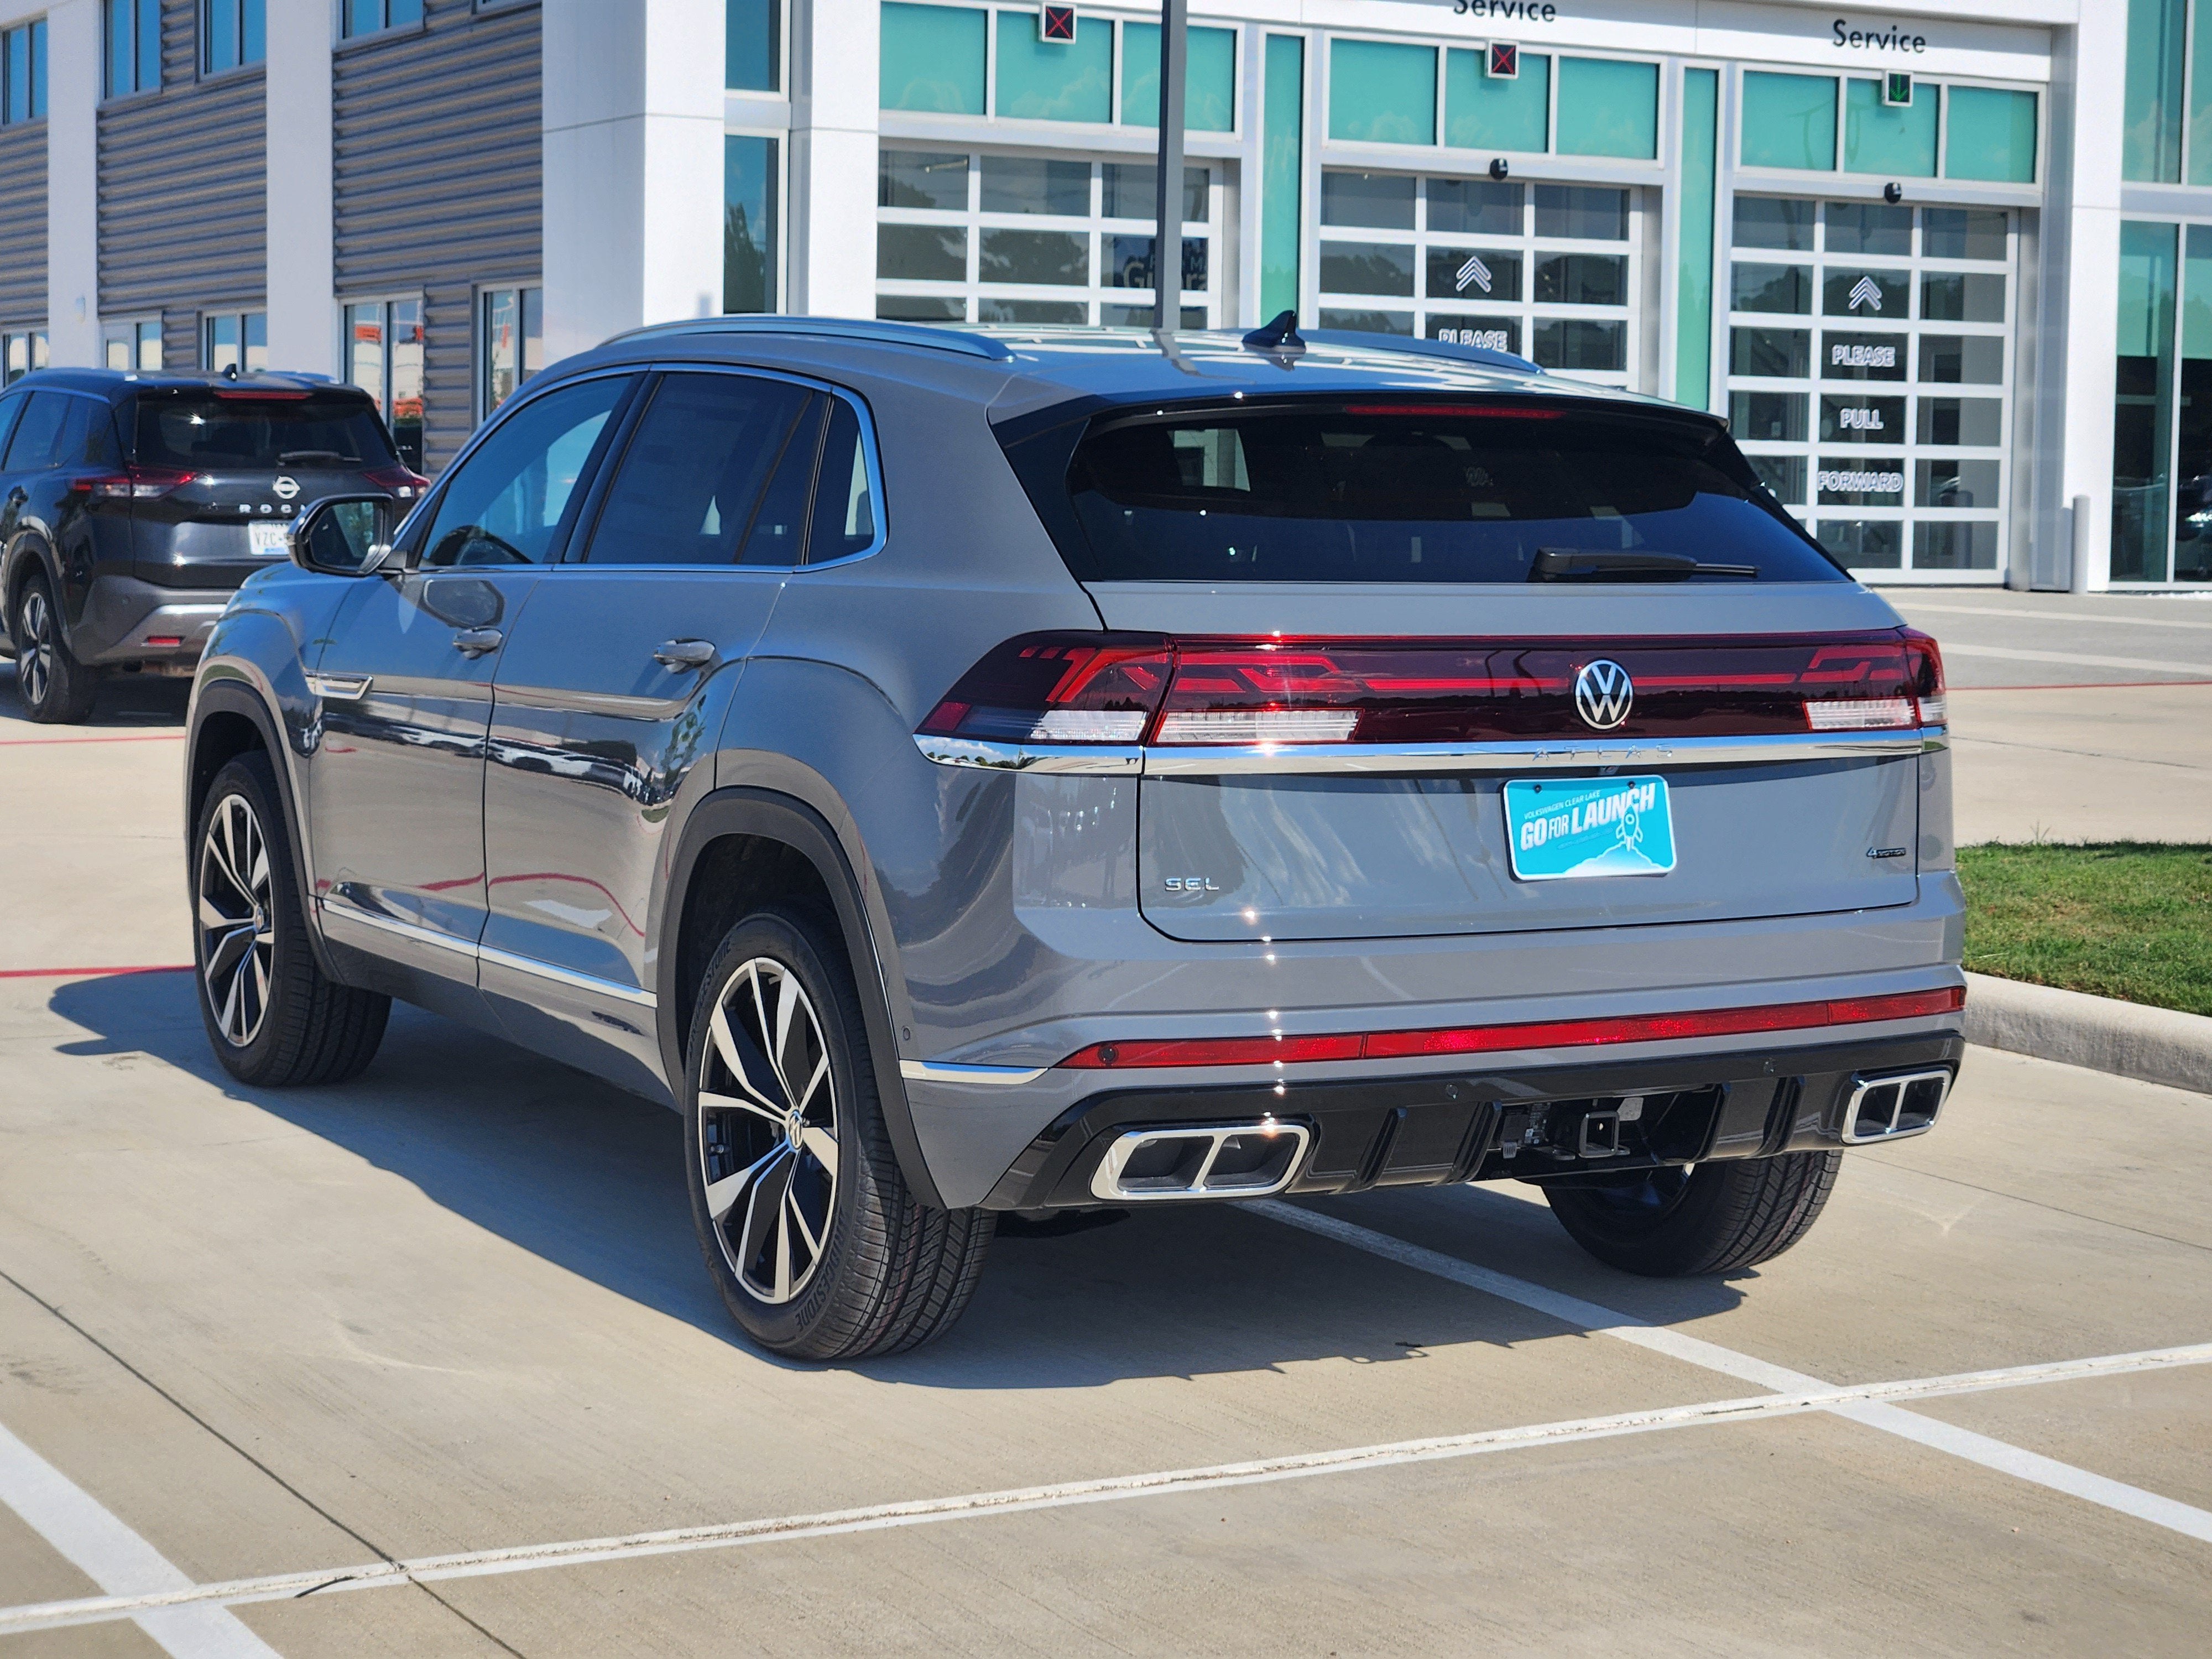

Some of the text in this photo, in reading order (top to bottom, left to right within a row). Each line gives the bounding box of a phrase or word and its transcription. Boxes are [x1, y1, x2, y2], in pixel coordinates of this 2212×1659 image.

[1453, 0, 1556, 22] Service
[1833, 18, 1926, 53] Service
[1832, 345, 1896, 367] PLEASE
[1840, 408, 1884, 430] PULL
[1817, 471, 1904, 492] FORWARD
[1532, 744, 1673, 761] ATLAS
[1524, 790, 1600, 820] VOLKSWAGEN CLEAR LAKE
[1520, 817, 1547, 851] GO
[1548, 814, 1569, 839] FOR
[1572, 782, 1655, 834] LAUNCH
[1165, 877, 1219, 891] SEL
